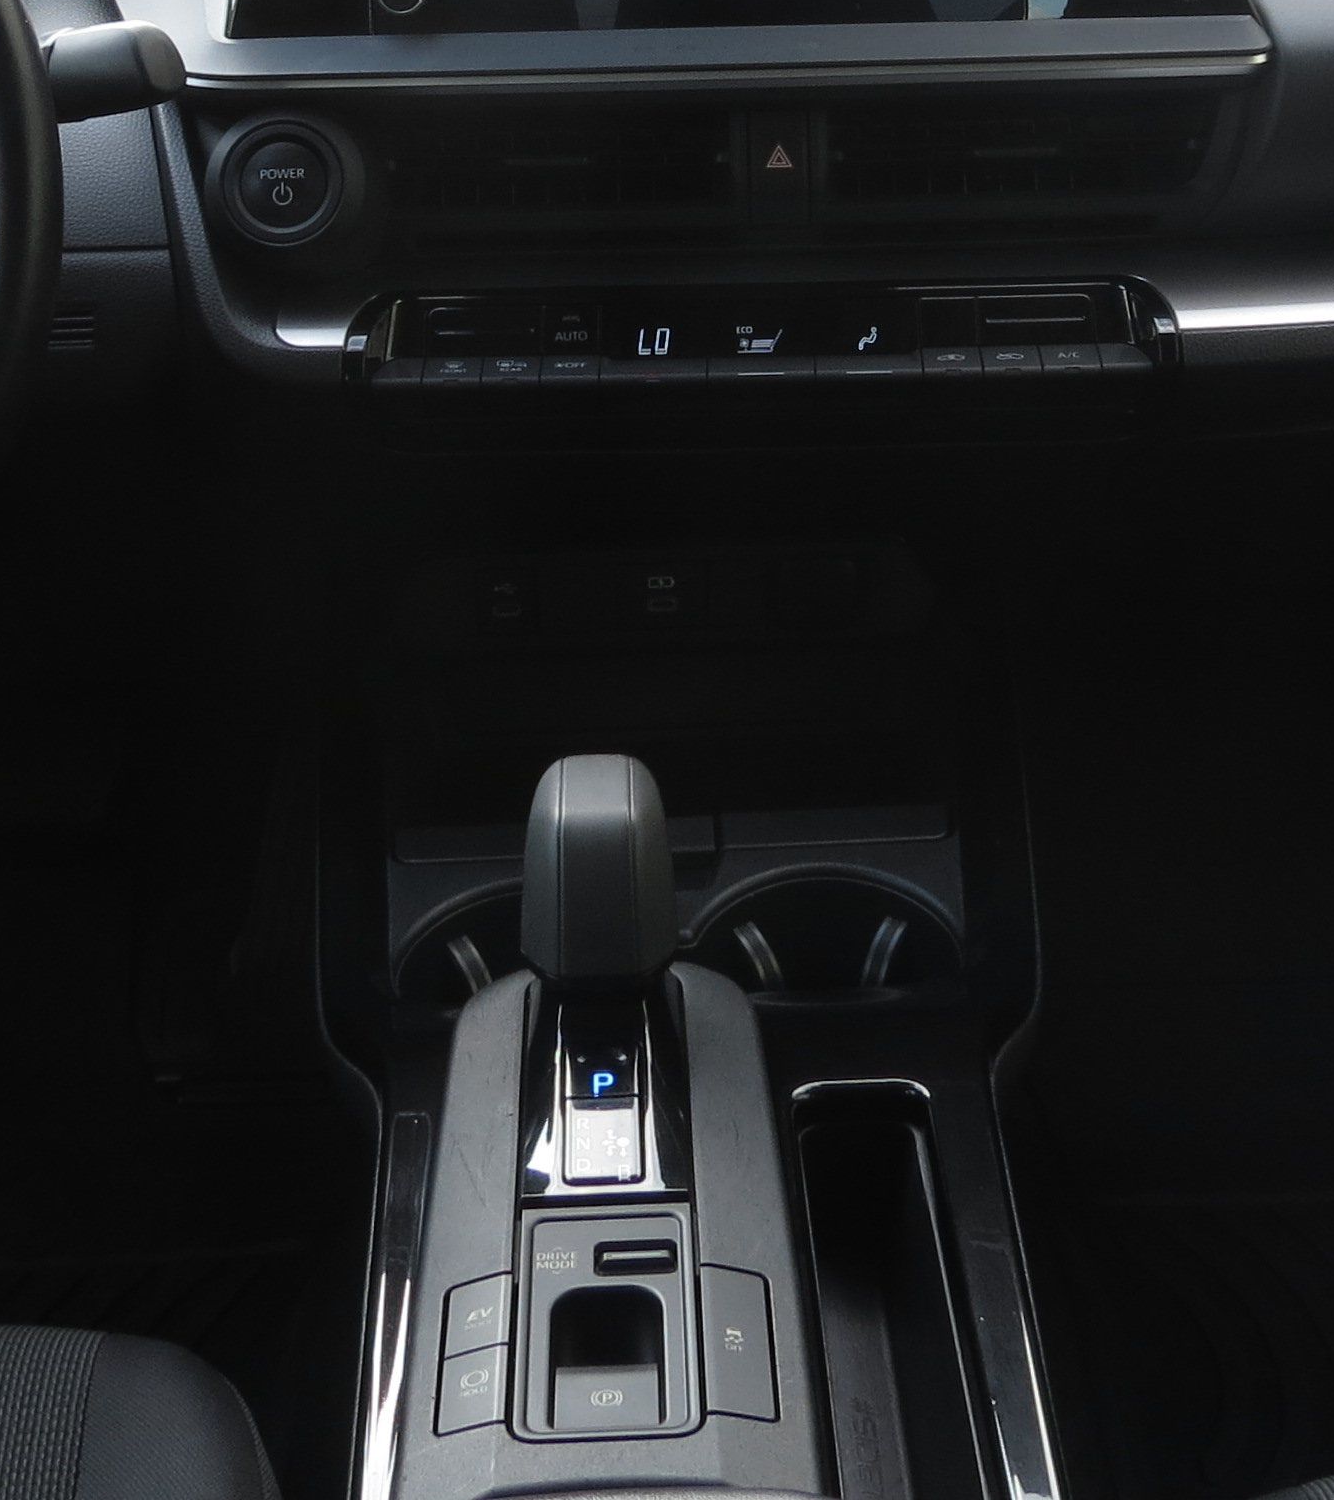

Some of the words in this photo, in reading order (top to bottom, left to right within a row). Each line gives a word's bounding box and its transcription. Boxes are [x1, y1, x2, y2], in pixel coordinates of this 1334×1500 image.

[259, 168, 305, 180] POWER
[735, 326, 753, 334] ECO
[555, 331, 588, 342] AUTO
[638, 327, 670, 357] LO
[593, 1072, 614, 1097] P
[577, 1118, 589, 1130] R
[577, 1138, 590, 1150] N
[577, 1158, 591, 1172] D
[536, 1252, 578, 1261] DRIVE
[536, 1261, 577, 1270] MODE
[467, 1306, 495, 1322] EV
